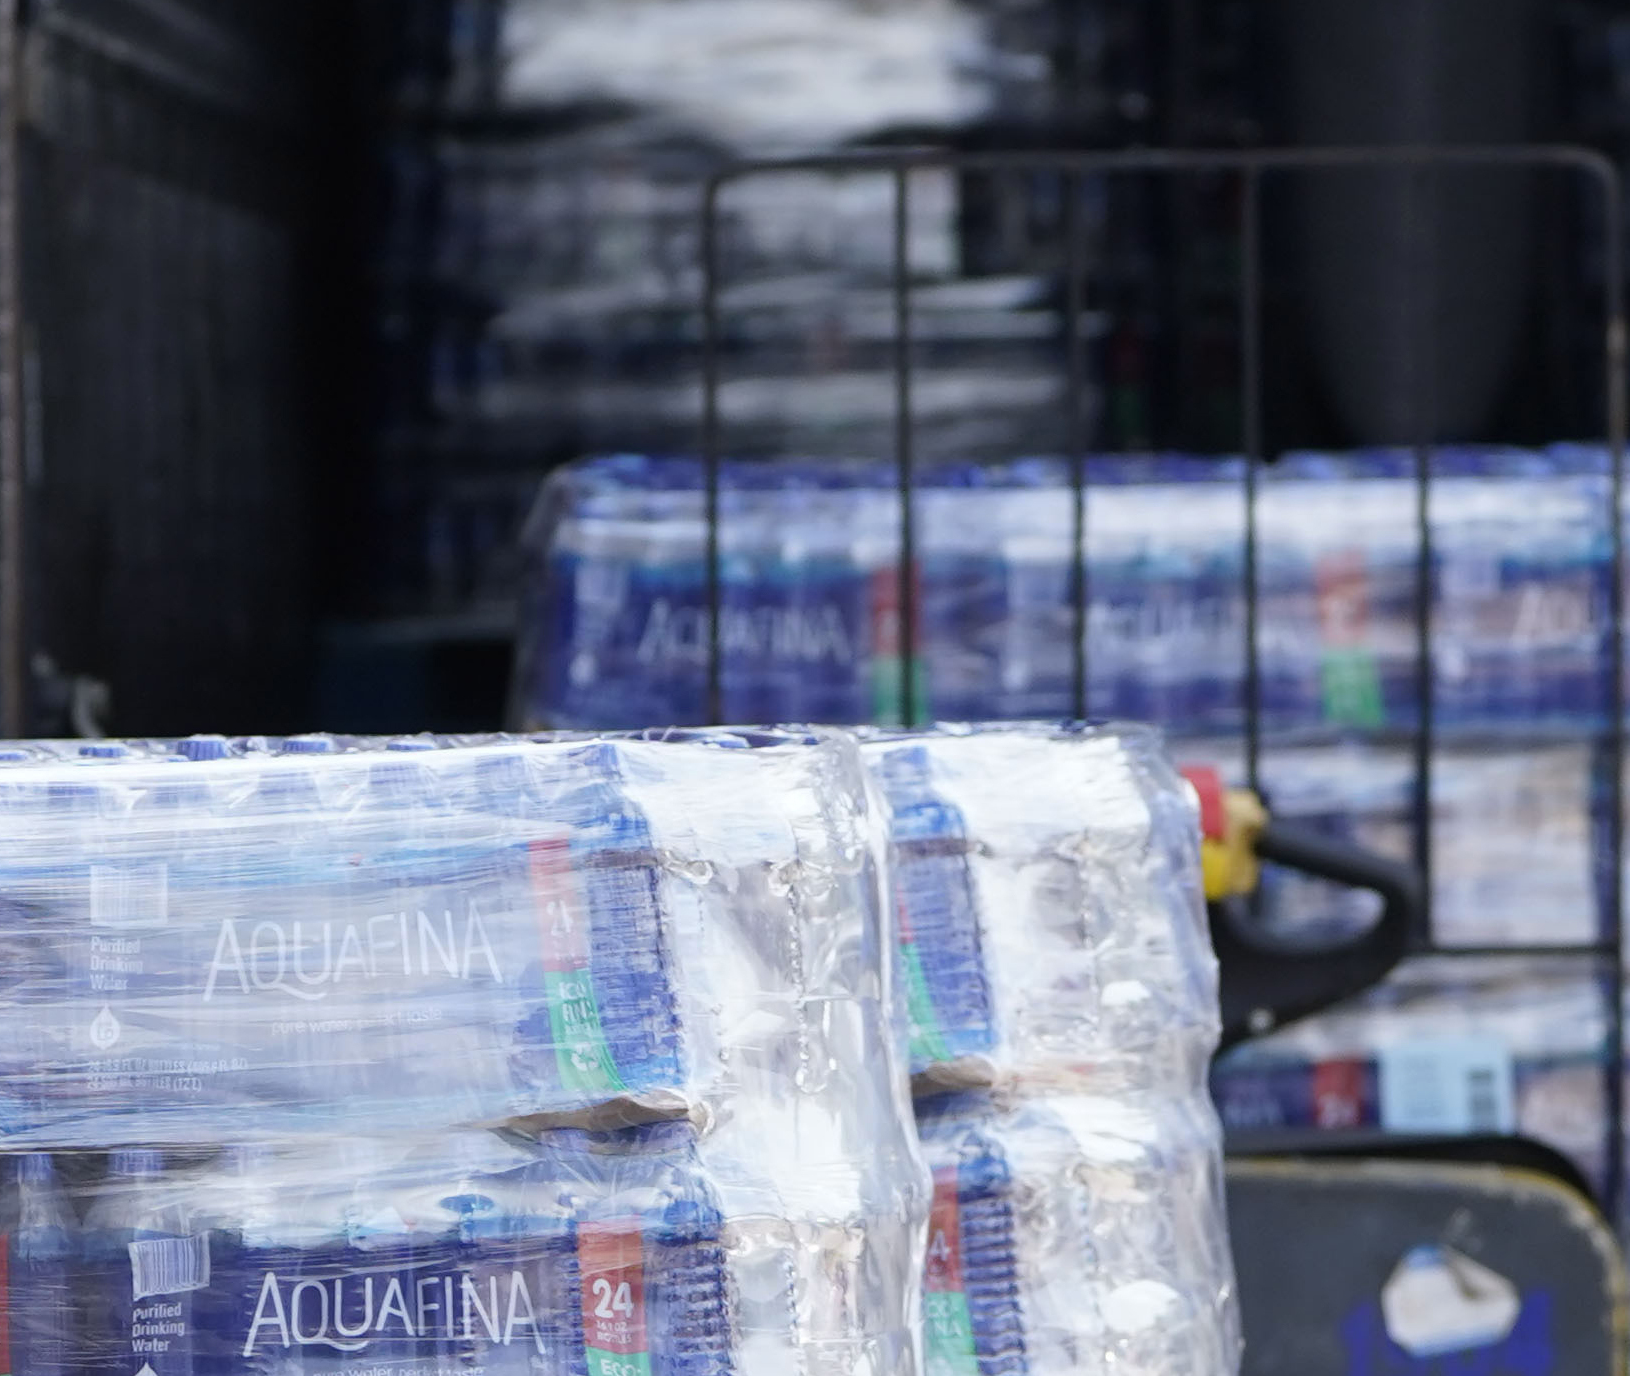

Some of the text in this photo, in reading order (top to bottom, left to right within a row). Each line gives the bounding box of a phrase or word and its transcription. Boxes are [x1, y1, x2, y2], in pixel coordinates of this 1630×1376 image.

[202, 900, 503, 1002] AQUAFINA
[132, 1302, 182, 1324] Purified
[243, 1270, 546, 1357] AQUAFINA
[592, 1278, 634, 1319] 24
[131, 1320, 185, 1338] Drinking
[131, 1338, 171, 1353] Water
